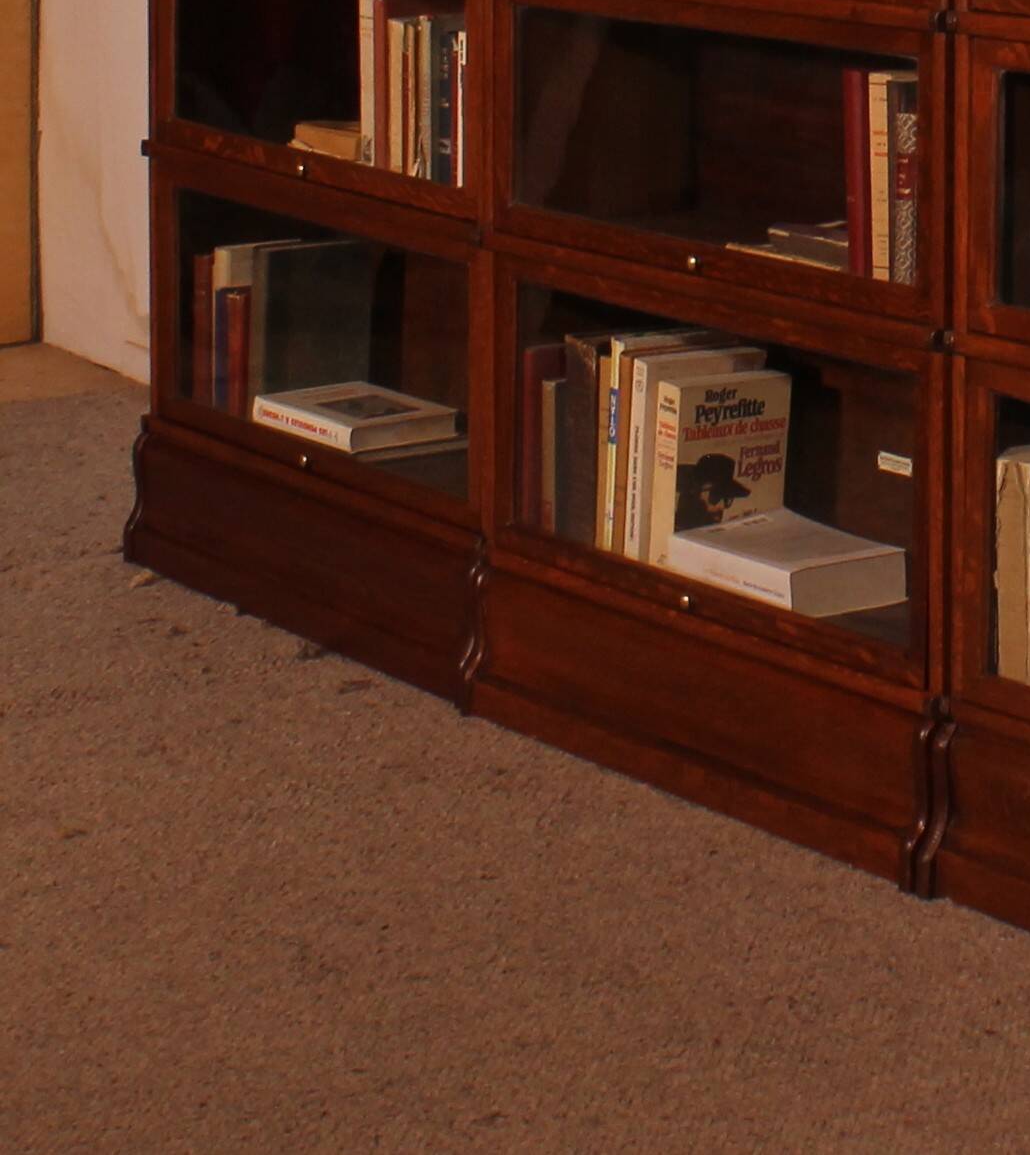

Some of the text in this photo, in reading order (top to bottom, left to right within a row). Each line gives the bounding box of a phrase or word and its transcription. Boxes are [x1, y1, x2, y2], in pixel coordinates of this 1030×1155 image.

[704, 388, 738, 404] Roger
[695, 398, 765, 427] Peyrefitte
[682, 423, 734, 442] Tableaux
[735, 420, 748, 435] de
[750, 416, 787, 434] chasse
[740, 440, 780, 459] Fernand
[737, 457, 783, 481] Legros
